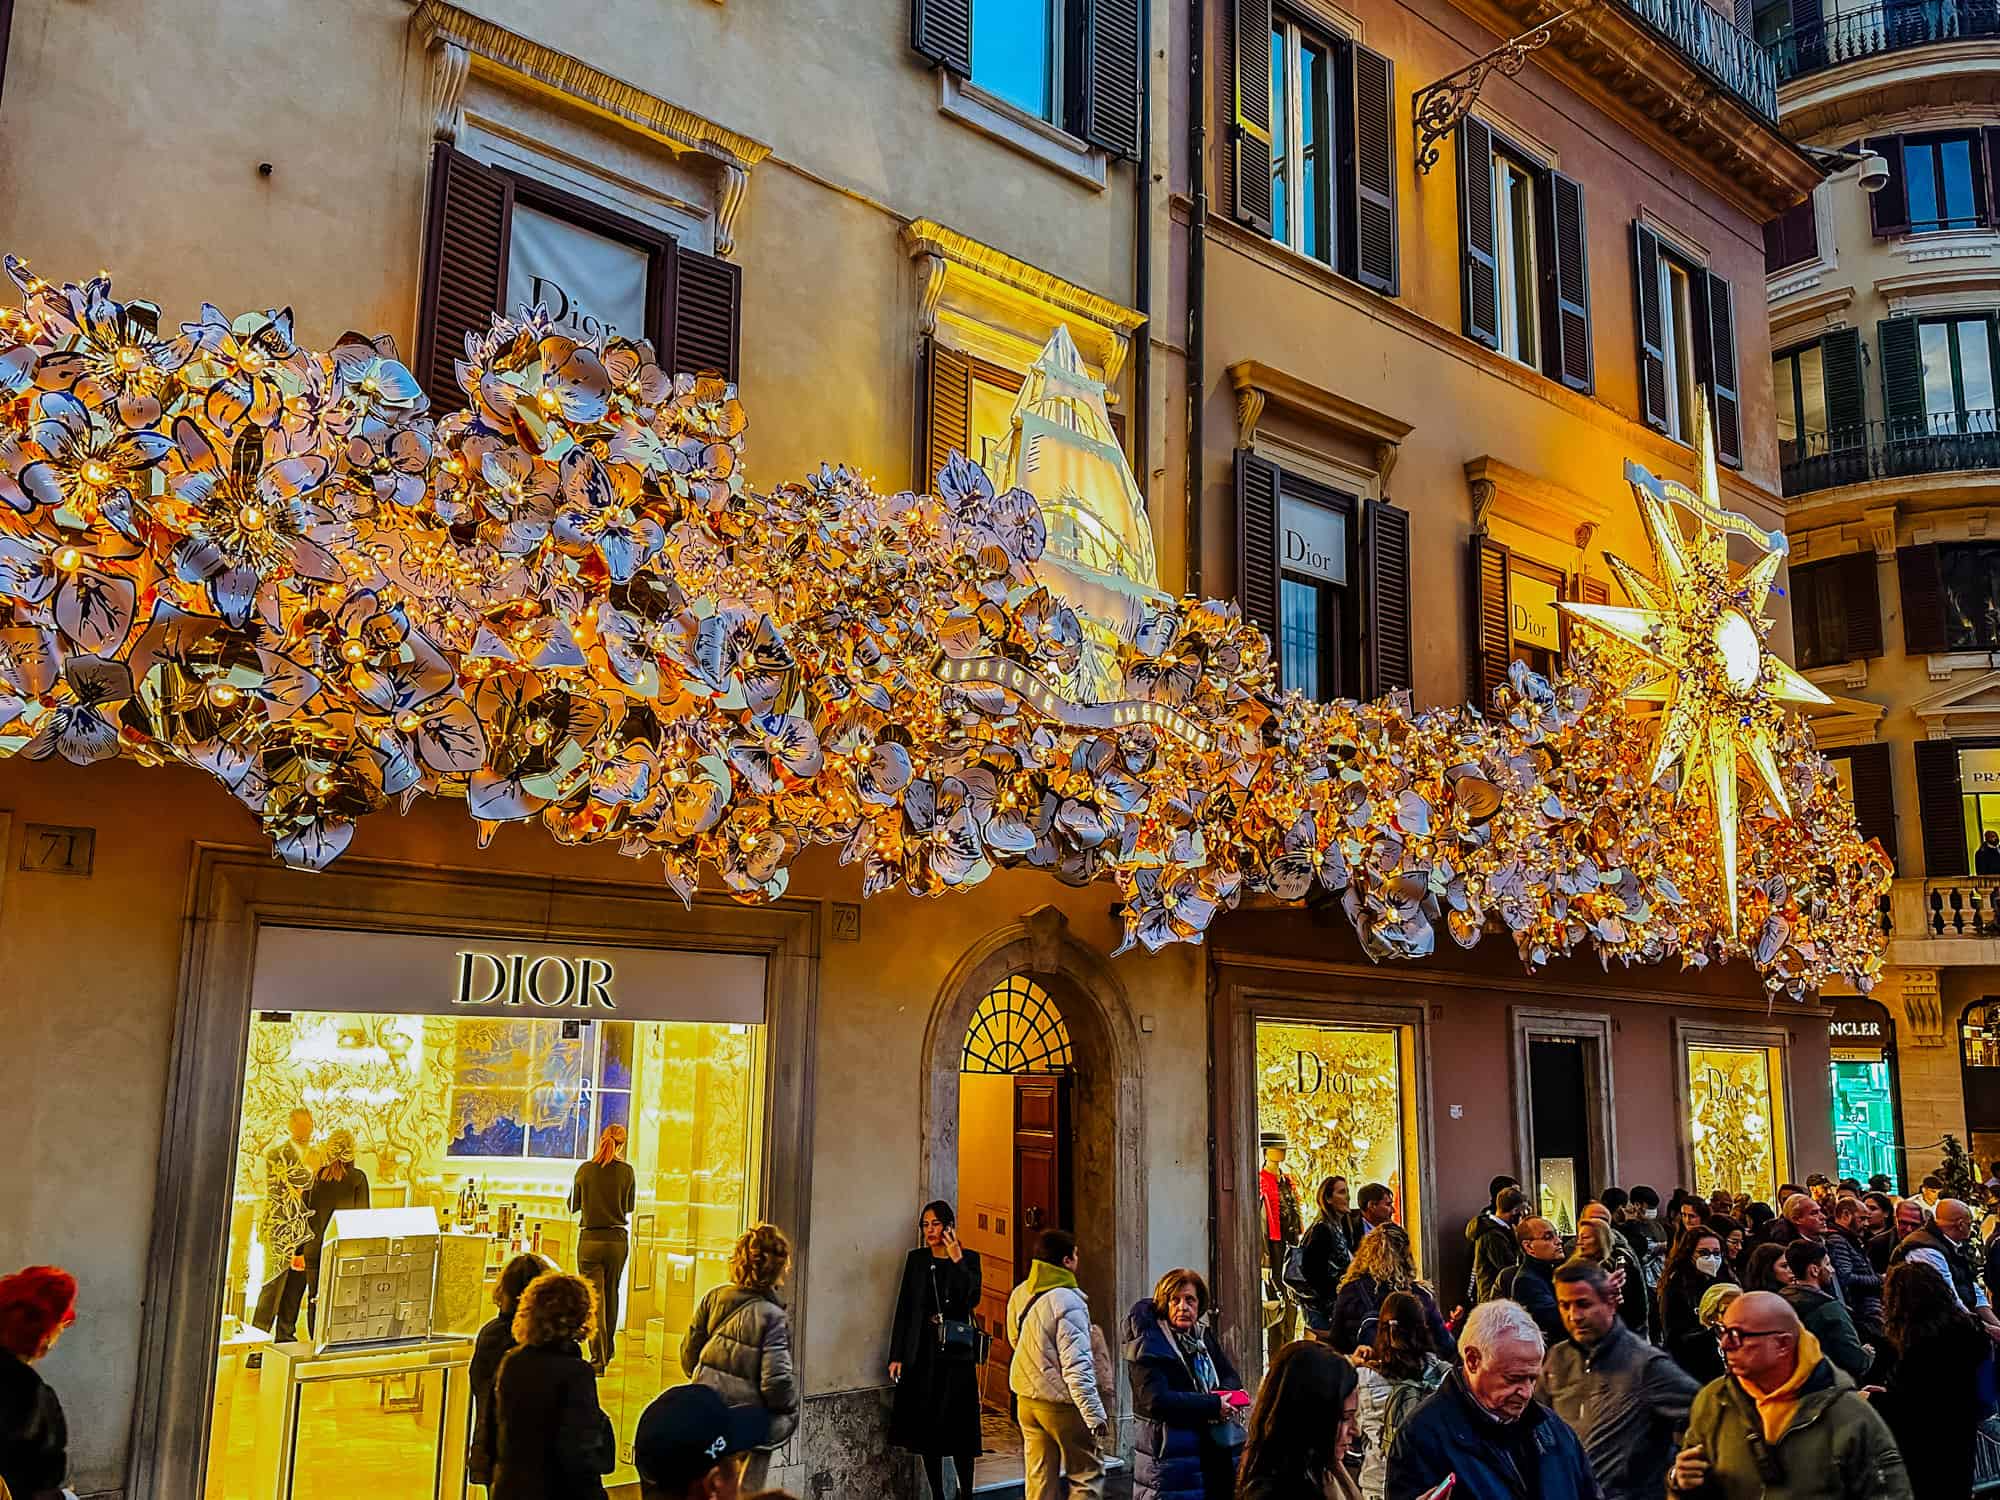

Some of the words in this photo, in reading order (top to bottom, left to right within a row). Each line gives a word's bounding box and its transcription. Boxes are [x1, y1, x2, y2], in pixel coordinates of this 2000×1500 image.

[528, 274, 617, 336] Dior
[1285, 529, 1331, 570] Dior
[1513, 604, 1547, 638] Dior
[452, 951, 617, 1009] DIOR
[1829, 1022, 1880, 1036] NCLER
[1294, 1050, 1358, 1094] Dior
